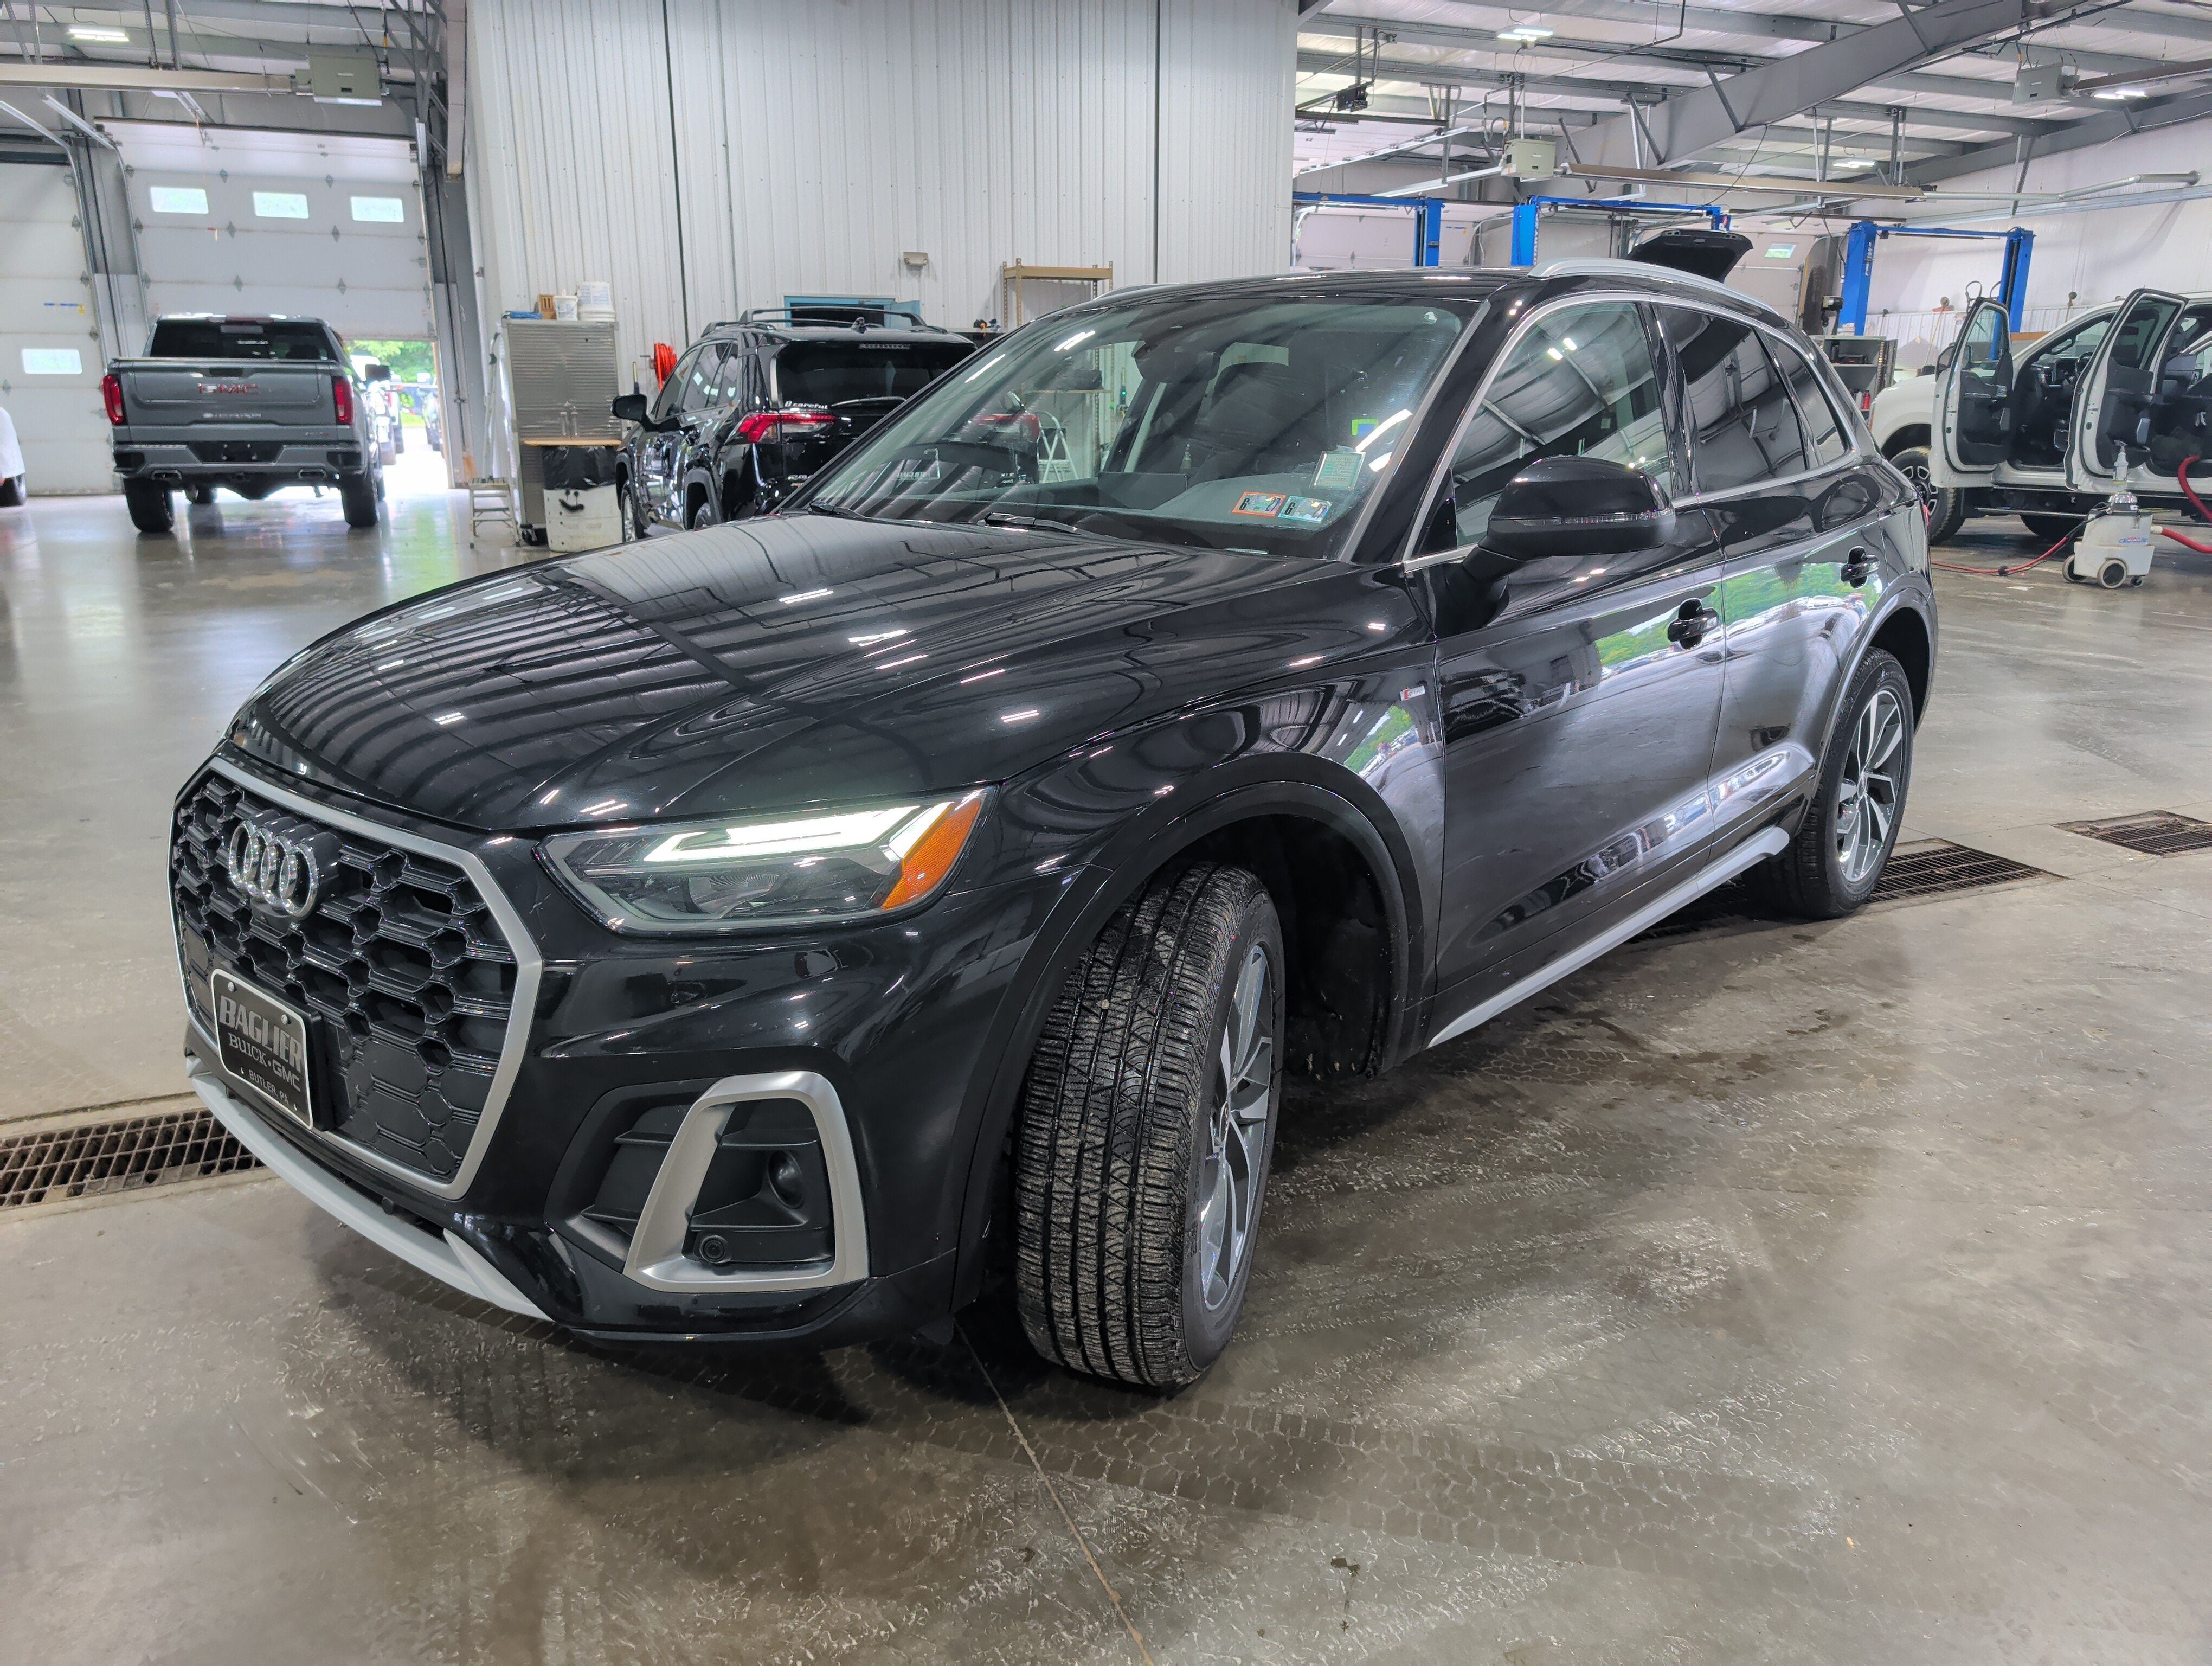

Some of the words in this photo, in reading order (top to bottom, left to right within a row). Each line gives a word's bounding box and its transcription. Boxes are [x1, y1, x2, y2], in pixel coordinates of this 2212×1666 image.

[197, 383, 261, 395] GMC
[1239, 498, 1250, 510] 6
[1265, 497, 1282, 512] 27
[1284, 502, 1295, 515] 6
[219, 996, 303, 1073] BAGLIER
[227, 1033, 268, 1067] BUICK
[272, 1060, 301, 1092] GMC
[248, 1069, 279, 1099] BUTLER,
[280, 1090, 289, 1105] PA
